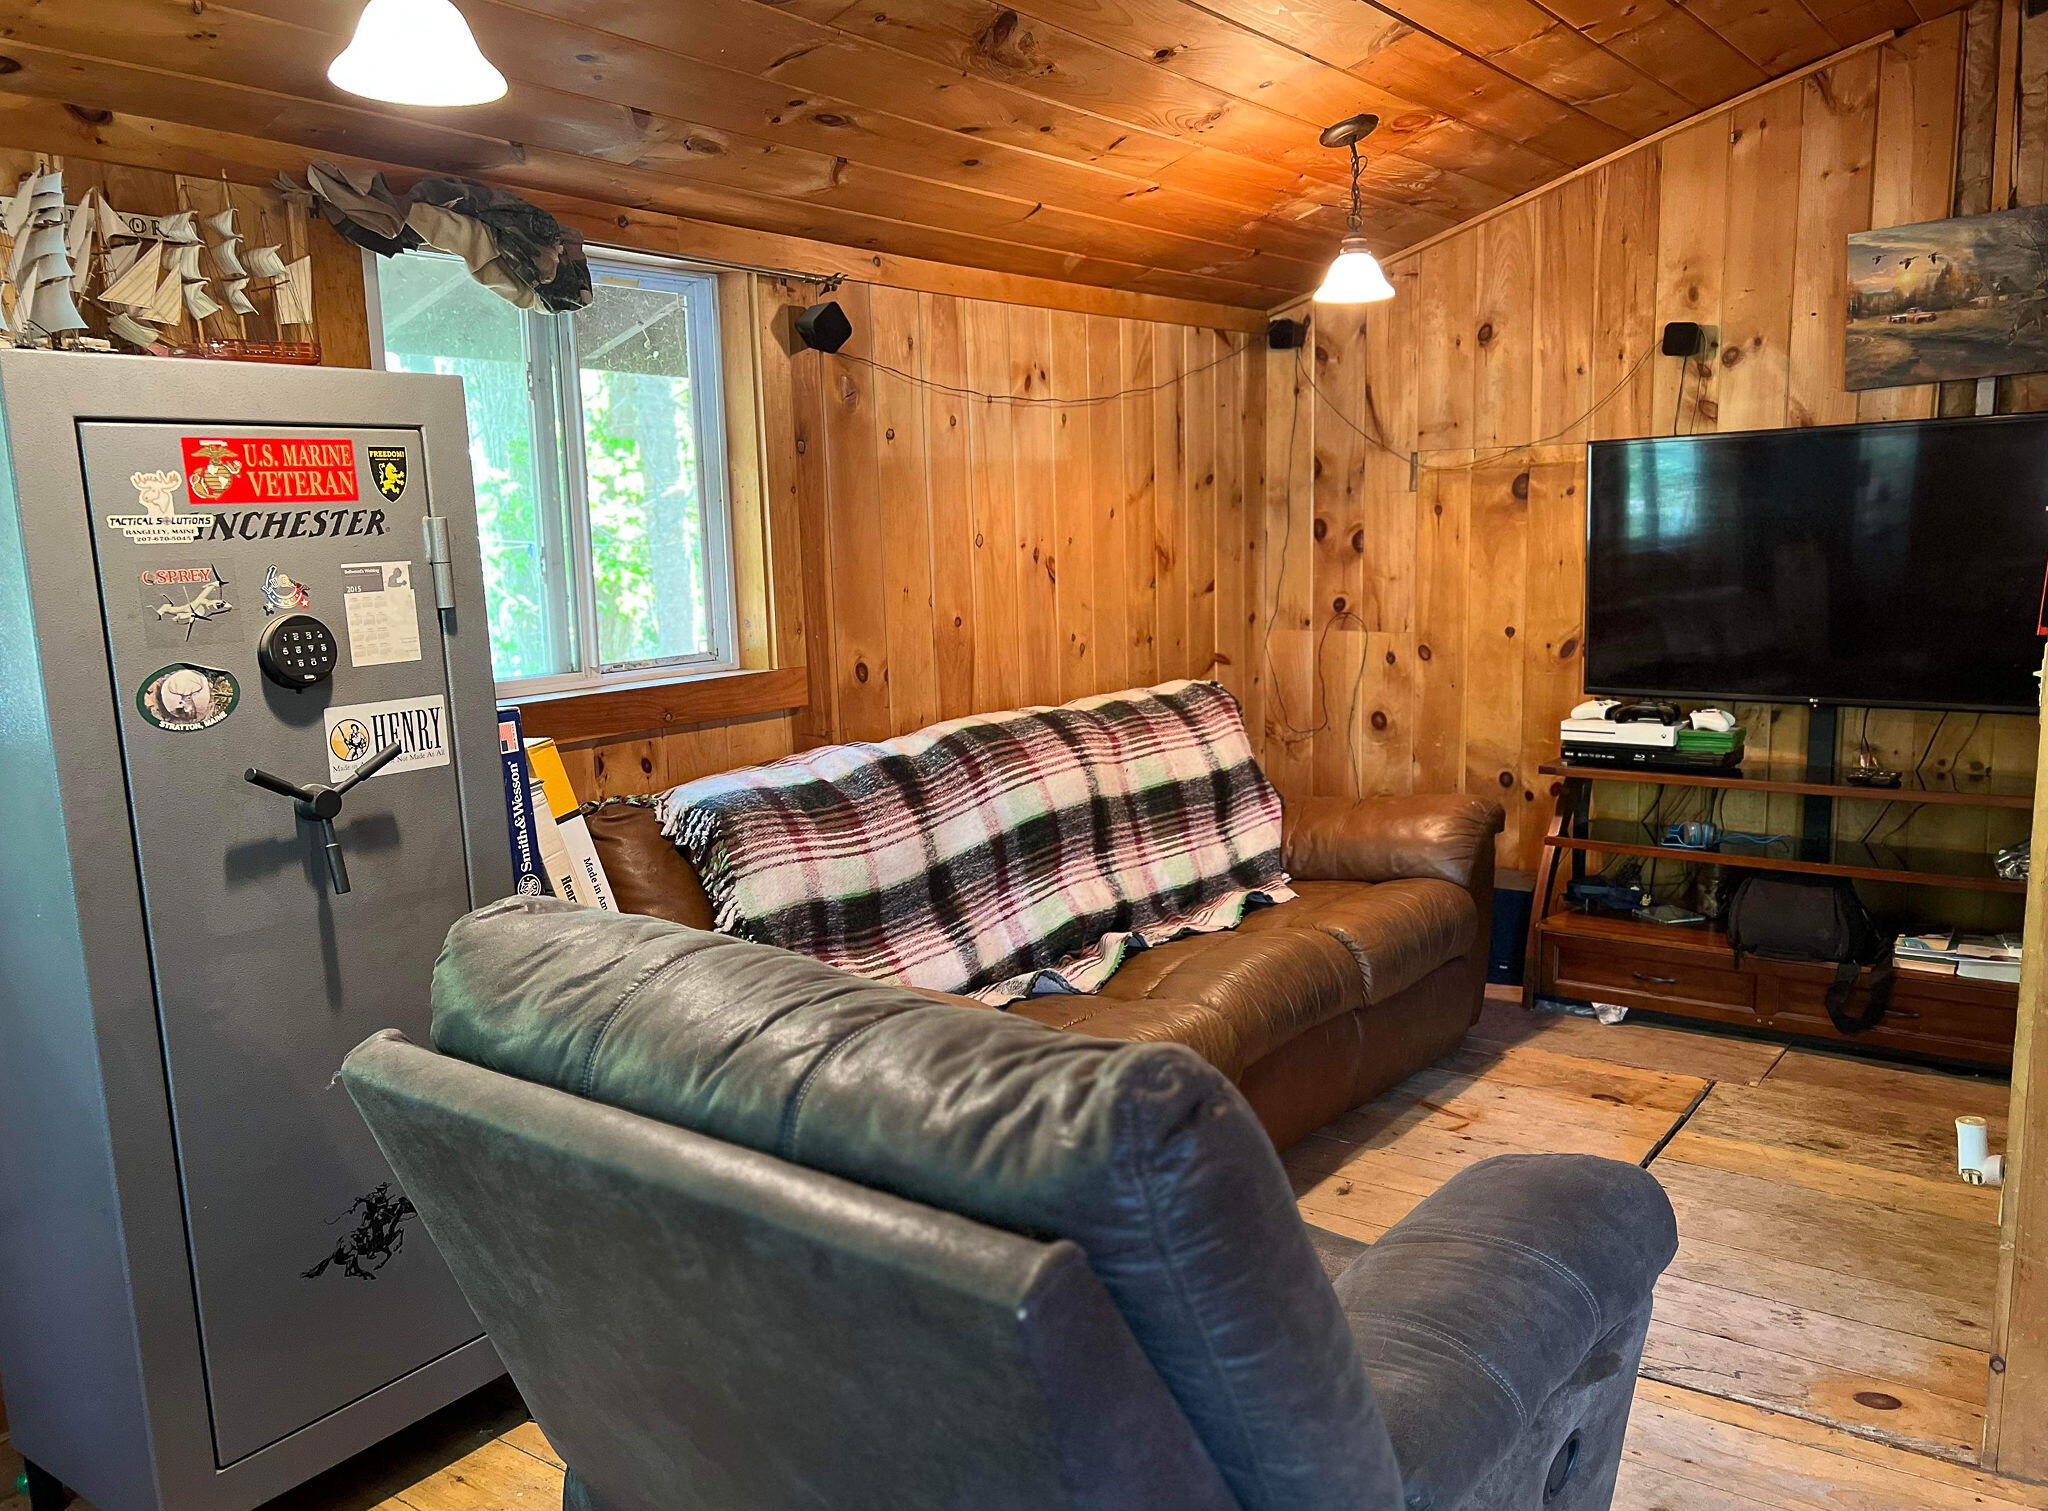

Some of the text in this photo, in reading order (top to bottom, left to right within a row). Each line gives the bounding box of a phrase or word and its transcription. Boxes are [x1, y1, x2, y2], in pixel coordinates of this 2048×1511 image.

[242, 443, 352, 467] U.S. MARINE
[246, 471, 355, 497] VETERAN
[371, 706, 440, 754] HENRY
[583, 857, 598, 883] Made
[594, 883, 602, 894] in
